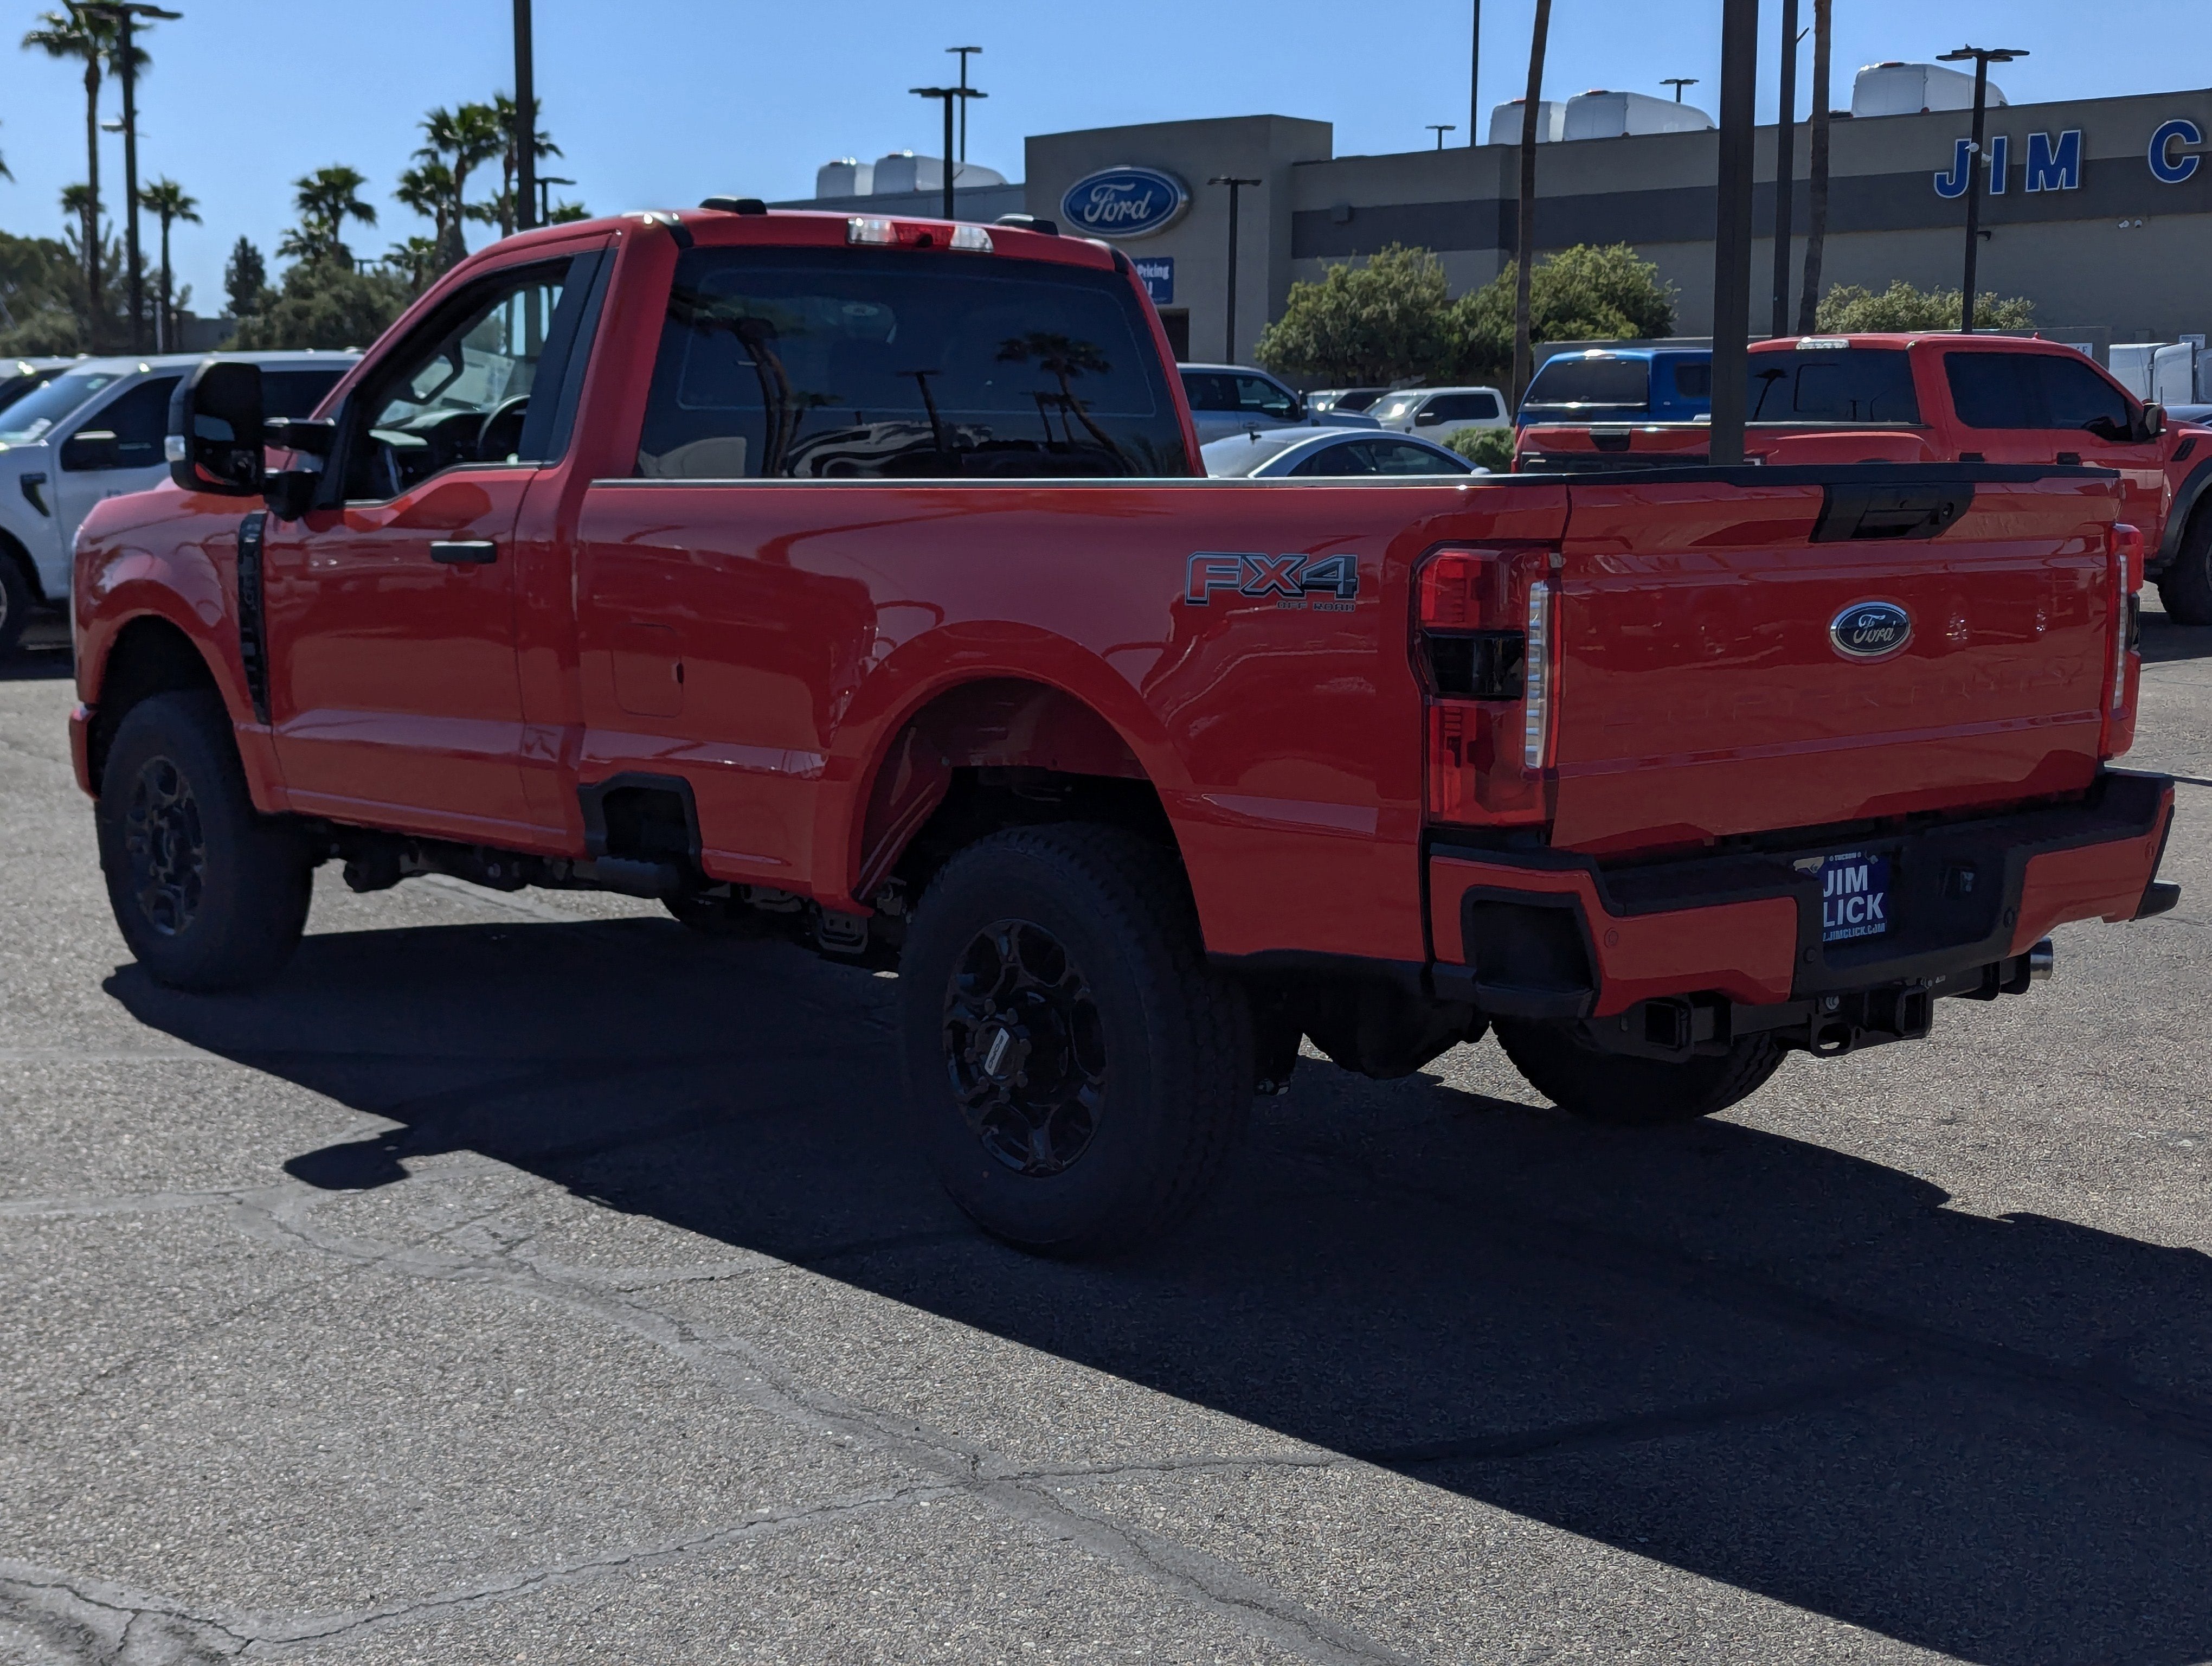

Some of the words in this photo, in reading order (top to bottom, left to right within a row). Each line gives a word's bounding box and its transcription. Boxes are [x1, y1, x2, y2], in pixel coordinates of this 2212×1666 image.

[1934, 130, 2081, 198] JIM
[1085, 182, 1152, 222] Ford
[1185, 551, 1359, 606] FX4
[1277, 600, 1308, 610] OFF
[1313, 601, 1355, 612] ROAD
[1853, 614, 1896, 644] Ford
[1823, 865, 1868, 898] JIM
